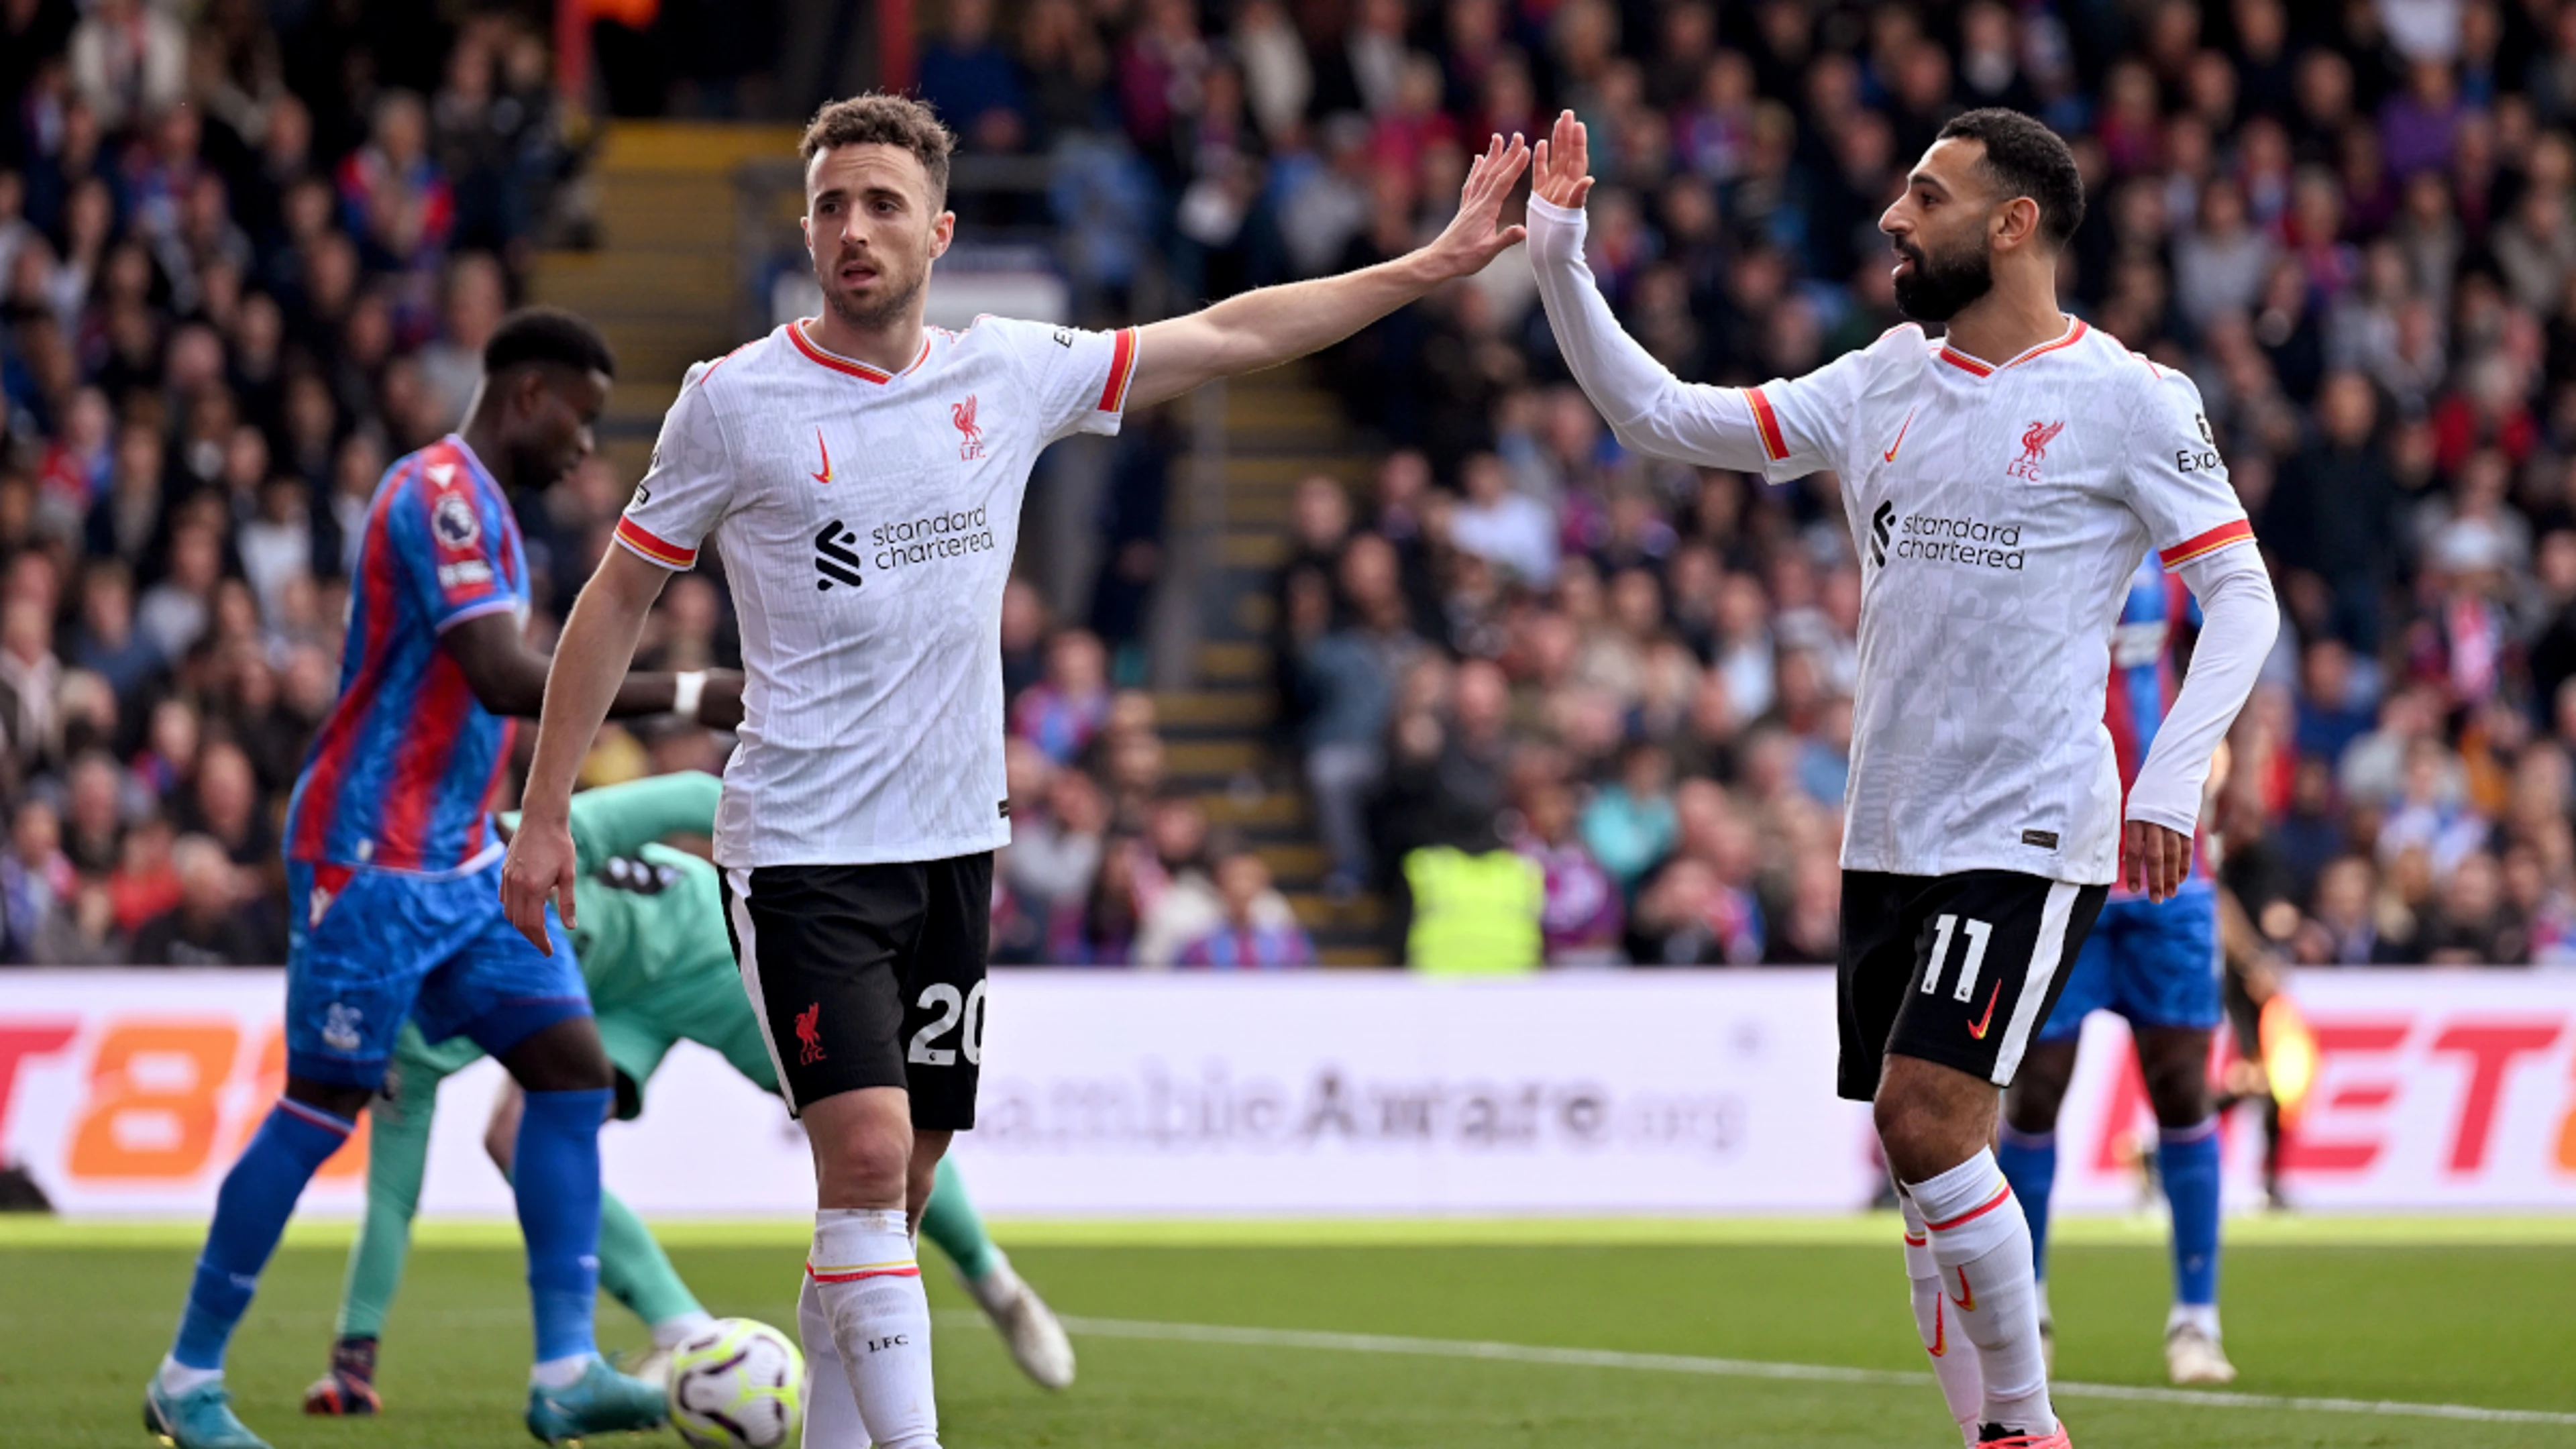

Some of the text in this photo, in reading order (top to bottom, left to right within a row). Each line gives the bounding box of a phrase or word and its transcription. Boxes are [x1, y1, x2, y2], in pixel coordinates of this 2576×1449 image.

[2176, 448, 2223, 474] Exp
[872, 504, 987, 547] standard
[1902, 513, 2021, 546] standard
[875, 526, 995, 570] chartered
[1897, 537, 2025, 571] chartered
[1920, 914, 1993, 1004] 11
[908, 978, 987, 1067] 20
[867, 1334, 909, 1354] LFC
